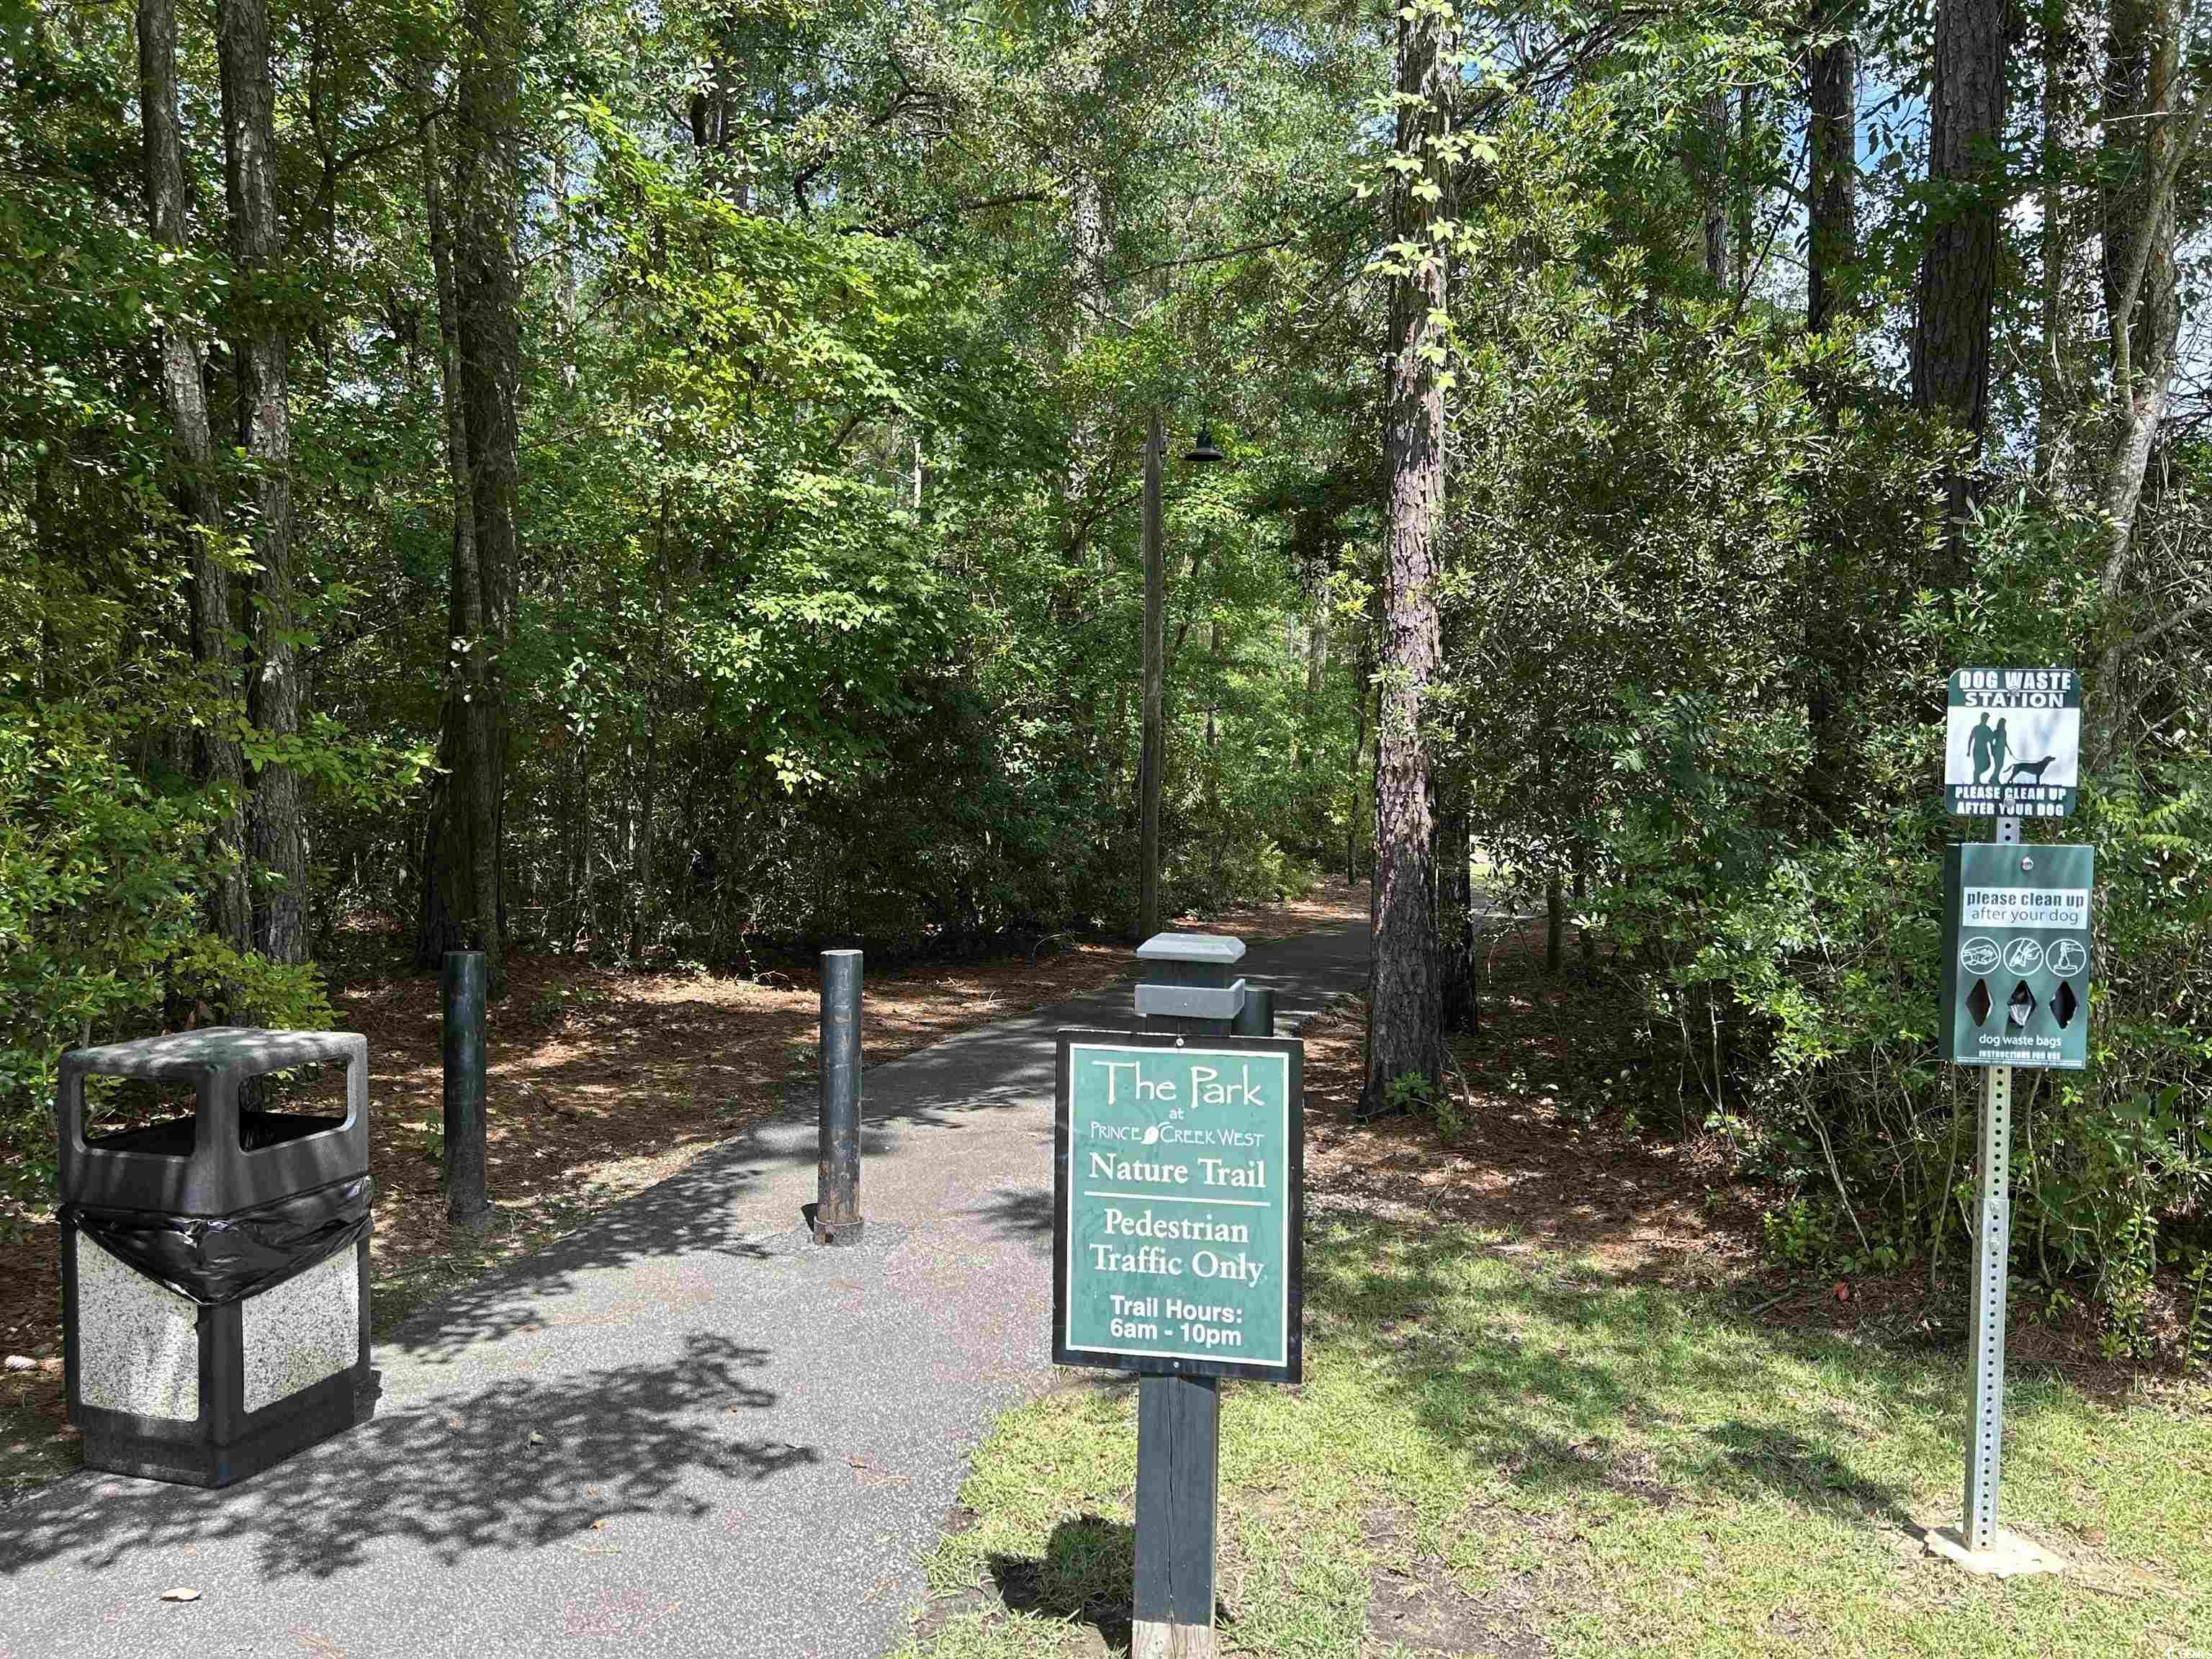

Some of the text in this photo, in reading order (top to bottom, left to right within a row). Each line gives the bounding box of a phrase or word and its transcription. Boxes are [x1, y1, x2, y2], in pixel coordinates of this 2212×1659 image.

[1959, 671, 2072, 690] DOG WASTE
[1964, 692, 2064, 708] STATION
[1955, 786, 2067, 801] PLEASE CLEAN UP
[1956, 801, 2064, 817] AFTER YOUR DOG
[1967, 891, 2084, 908] please clean up
[1971, 907, 2079, 925] after your dog
[1979, 1033, 2062, 1048] dog waste bags
[1091, 1060, 1265, 1109] The Park
[1169, 1108, 1184, 1120] at
[1090, 1121, 1265, 1147] PRINCE CREEK WEST
[1089, 1152, 1267, 1188] Nature Trail
[1104, 1208, 1249, 1243] Pedestrian
[1089, 1244, 1264, 1288] Traffic Only
[1110, 1295, 1243, 1324] Trail Hours:
[1110, 1318, 1158, 1340] 6am
[1180, 1323, 1242, 1348] 10pm
